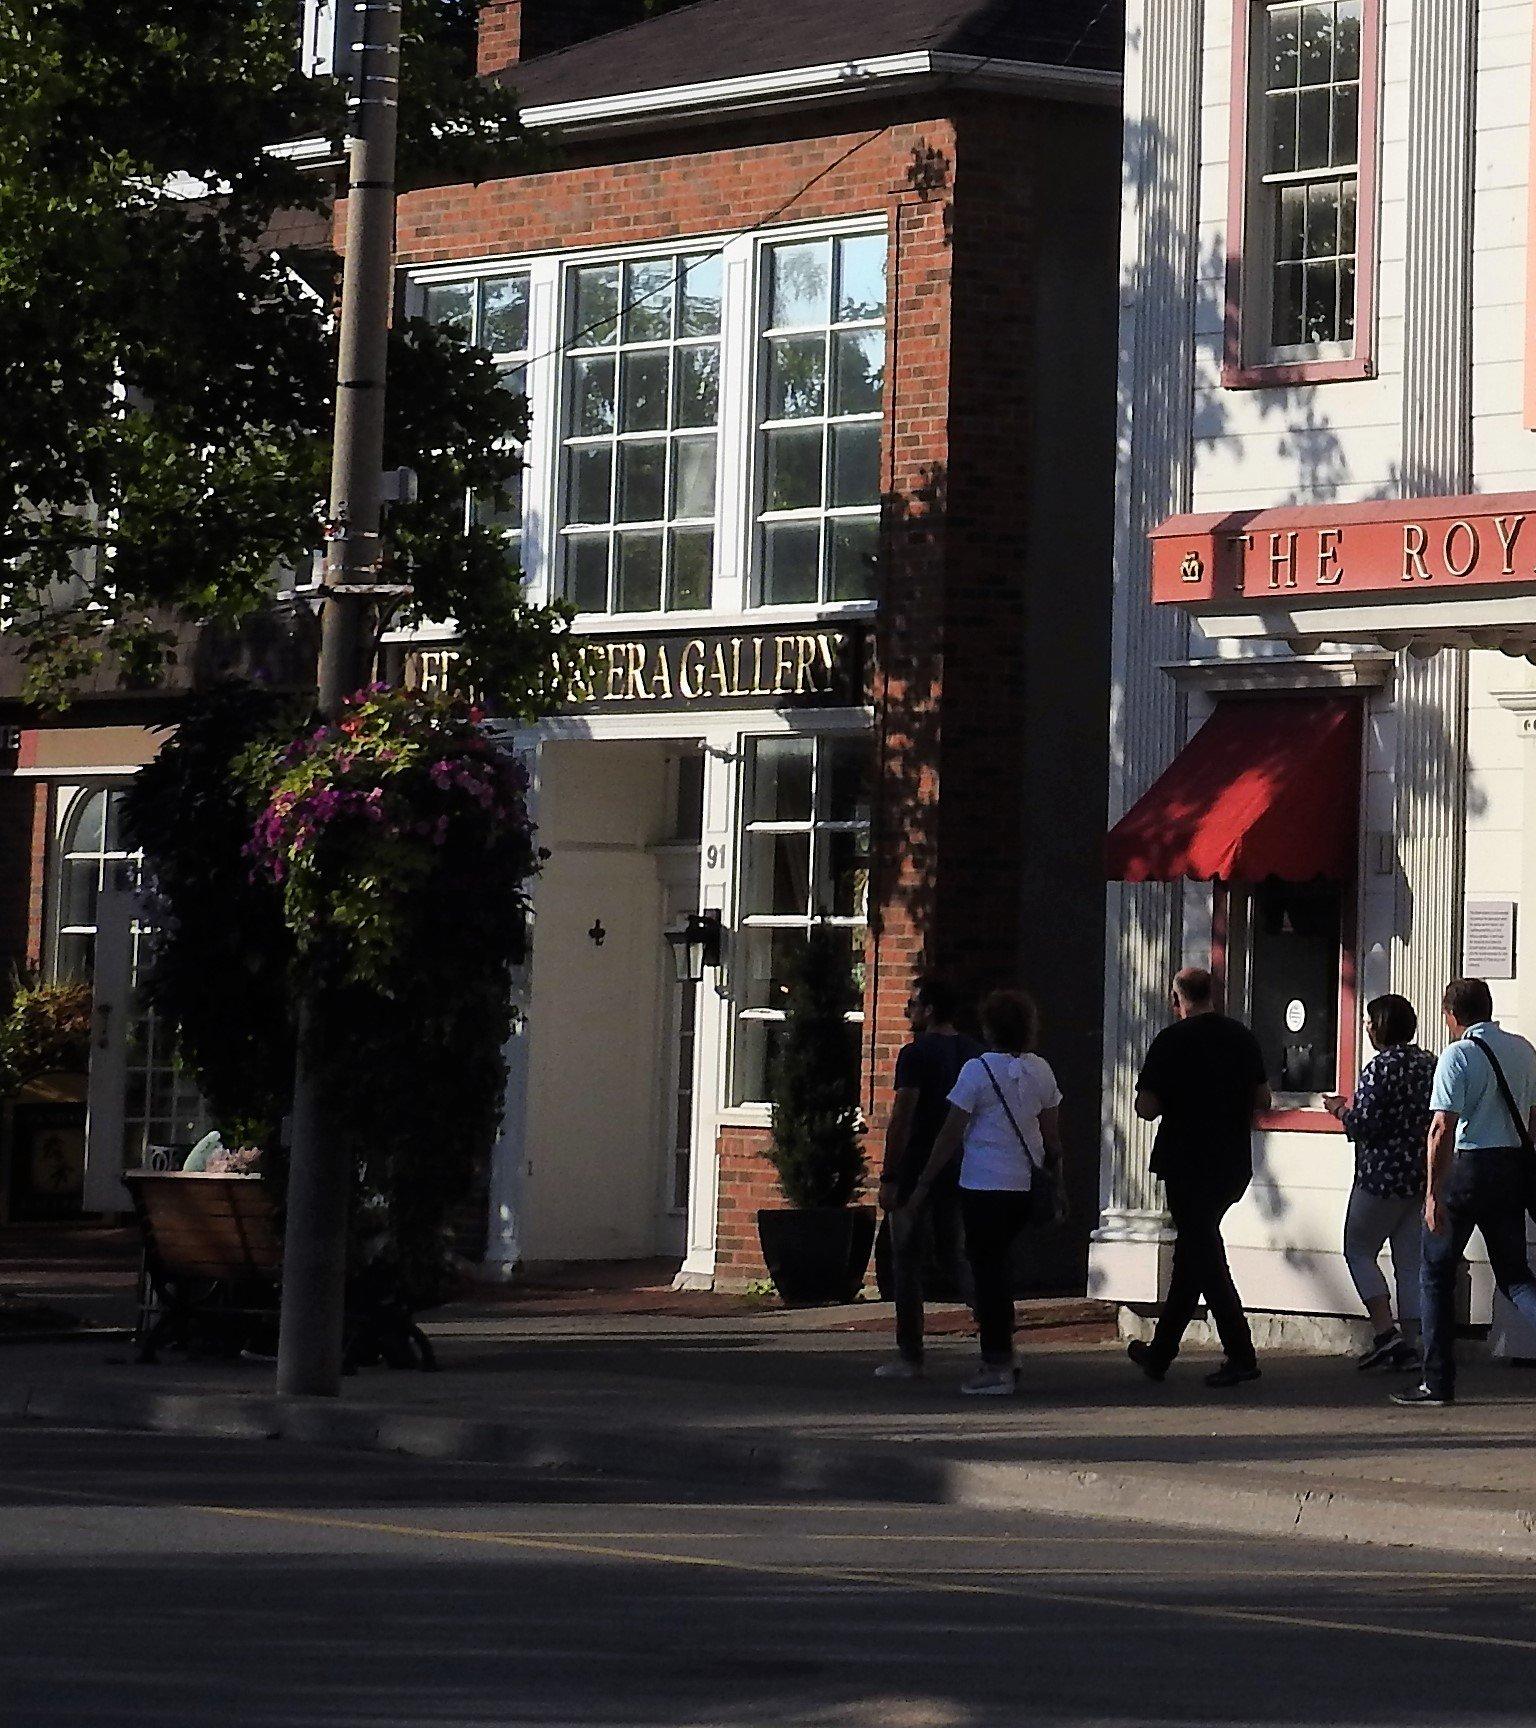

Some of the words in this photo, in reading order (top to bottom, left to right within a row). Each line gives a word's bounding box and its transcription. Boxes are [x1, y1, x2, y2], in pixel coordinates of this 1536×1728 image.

[1226, 527, 1343, 591] THE
[680, 633, 844, 699] GALLERY
[707, 843, 726, 870] 91
